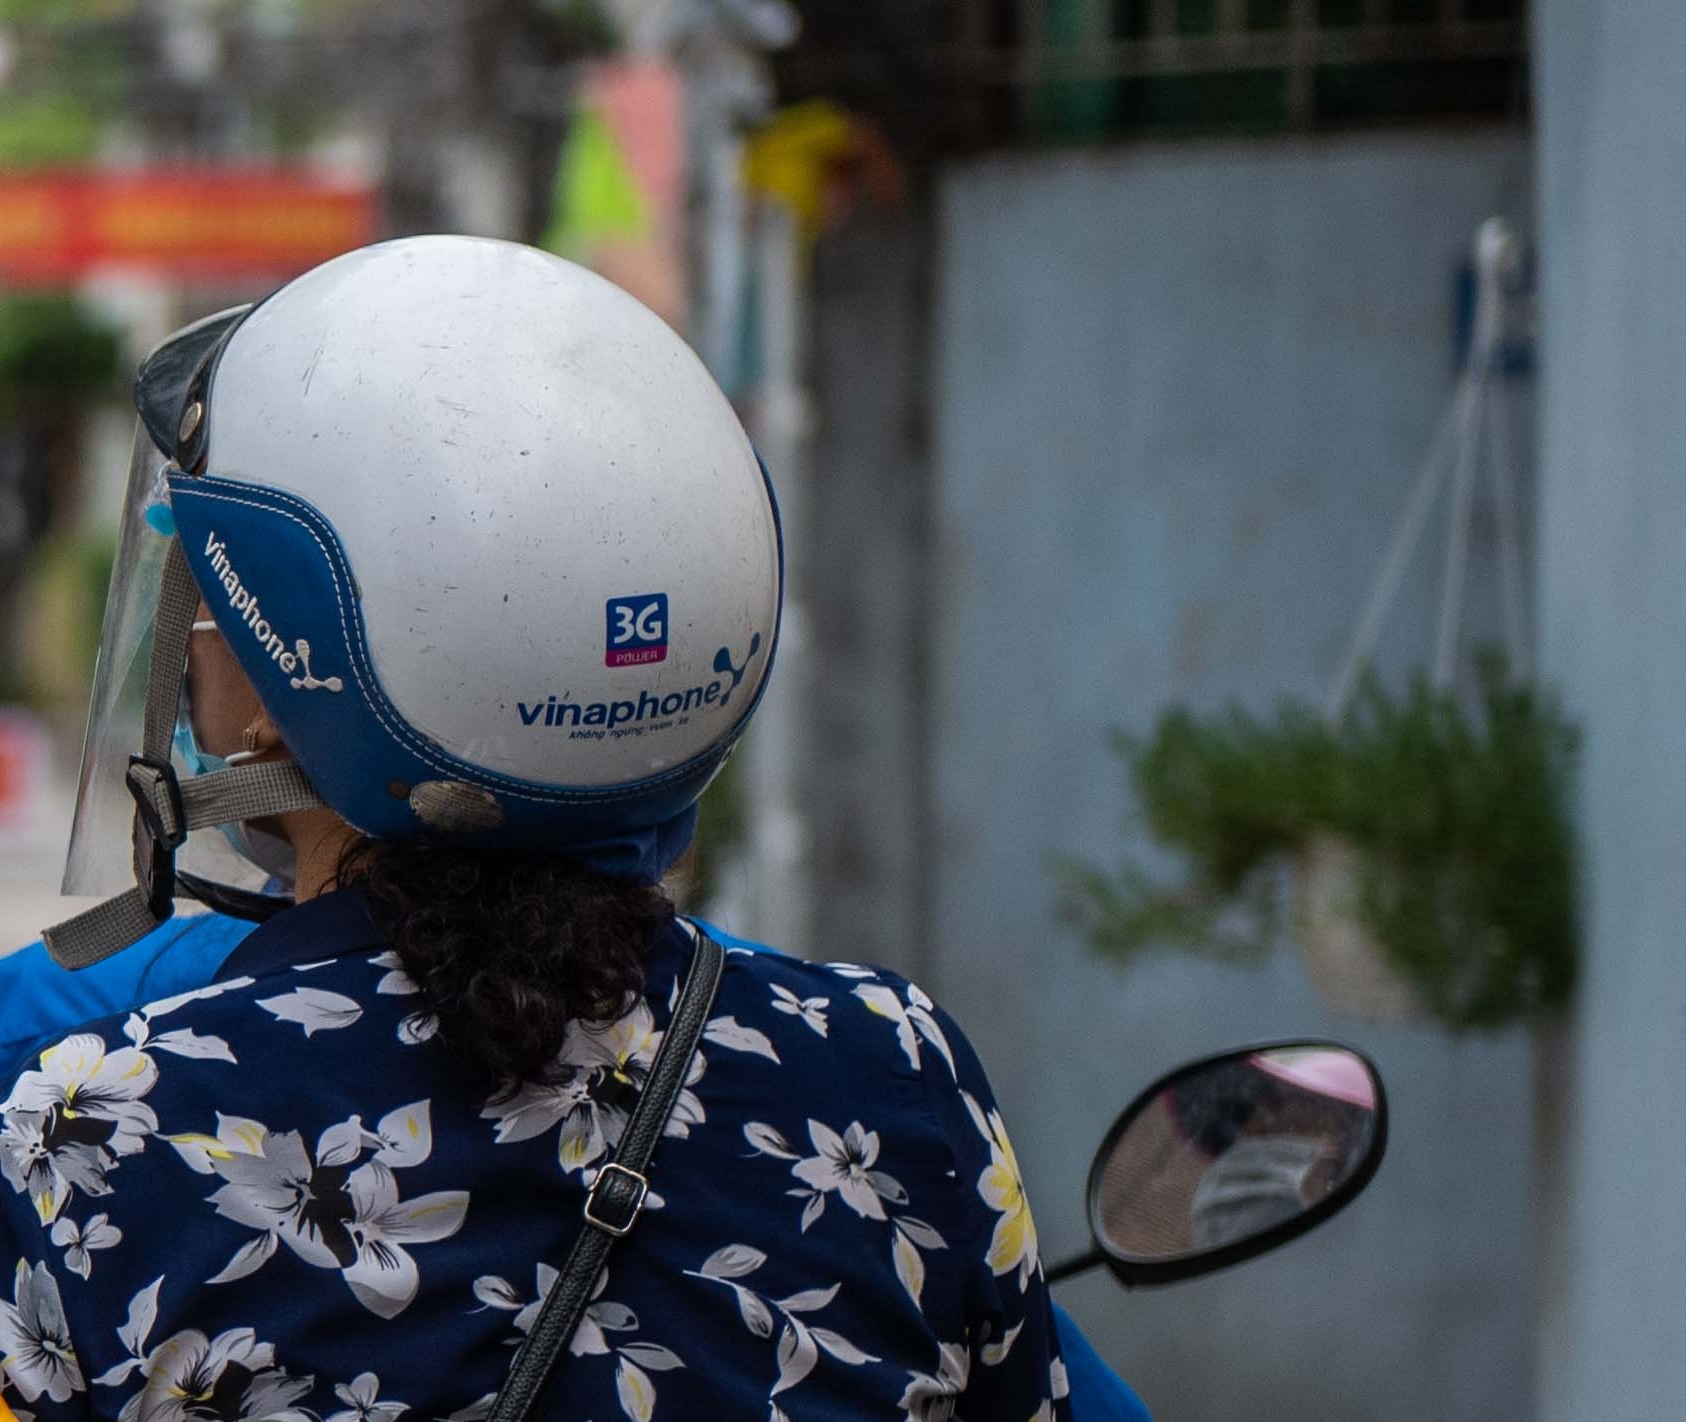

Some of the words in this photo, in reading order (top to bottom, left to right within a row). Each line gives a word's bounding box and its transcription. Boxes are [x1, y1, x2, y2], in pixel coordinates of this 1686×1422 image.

[204, 530, 297, 674] vinaphone
[613, 602, 662, 644] 3G
[616, 650, 658, 664] POWER
[517, 681, 722, 729] vinaphone
